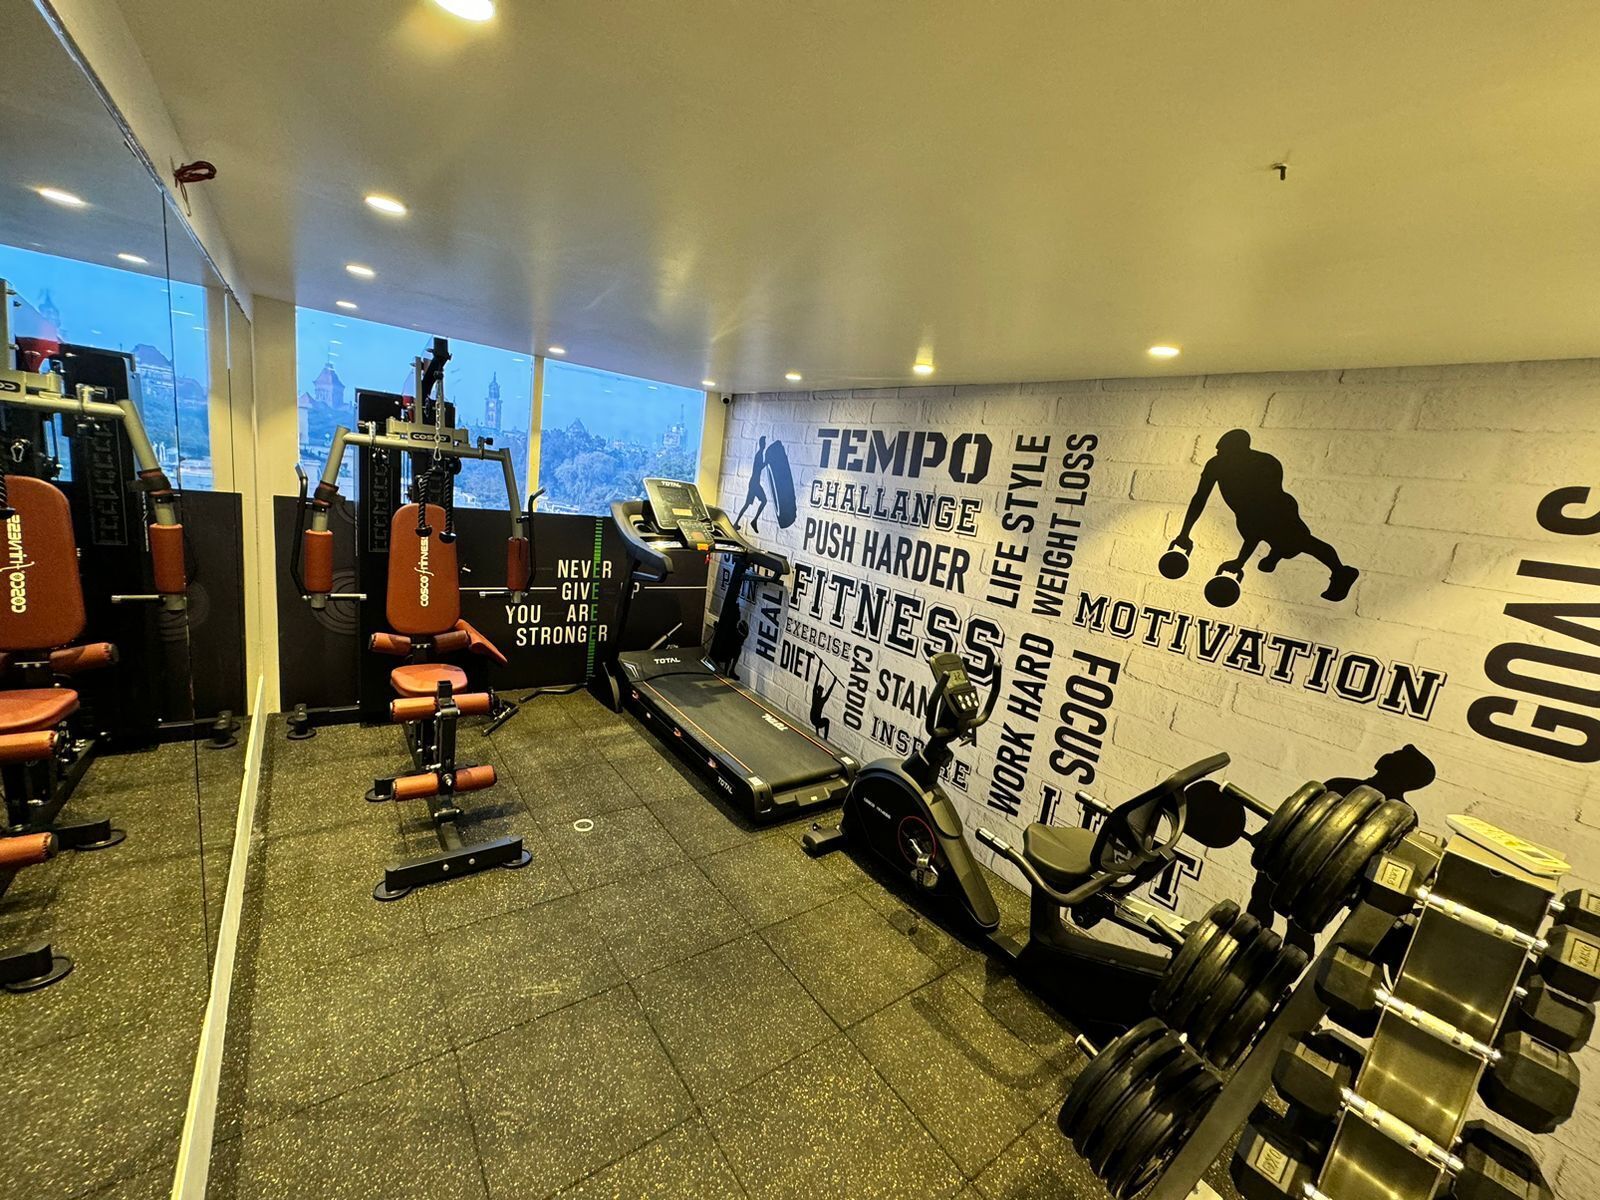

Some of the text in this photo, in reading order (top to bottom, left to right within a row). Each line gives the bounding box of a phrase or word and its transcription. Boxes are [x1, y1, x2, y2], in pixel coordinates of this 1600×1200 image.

[412, 433, 447, 441] COSO
[817, 428, 993, 485] TEMPO
[809, 480, 983, 537] CHALLANGE
[986, 434, 1051, 609] LIFE STYLE
[1031, 434, 1098, 617] WEIGHT LOSS
[557, 560, 612, 579] NEVER
[803, 517, 971, 595] PUSH HARDER
[420, 575, 429, 607] COSCO
[505, 604, 598, 624] YOU ARE
[561, 582, 600, 600] GIVE
[516, 625, 608, 647] STRONGER
[785, 617, 852, 662] EXERCISE
[787, 562, 1005, 689] FITNESS
[780, 639, 815, 682] DIET
[1073, 590, 1447, 722] MOTIVATION
[842, 646, 873, 731] CARDIO
[1048, 649, 1121, 785] FOCUS
[987, 632, 1054, 818] WORK HARD
[717, 776, 733, 795] TOTAL
